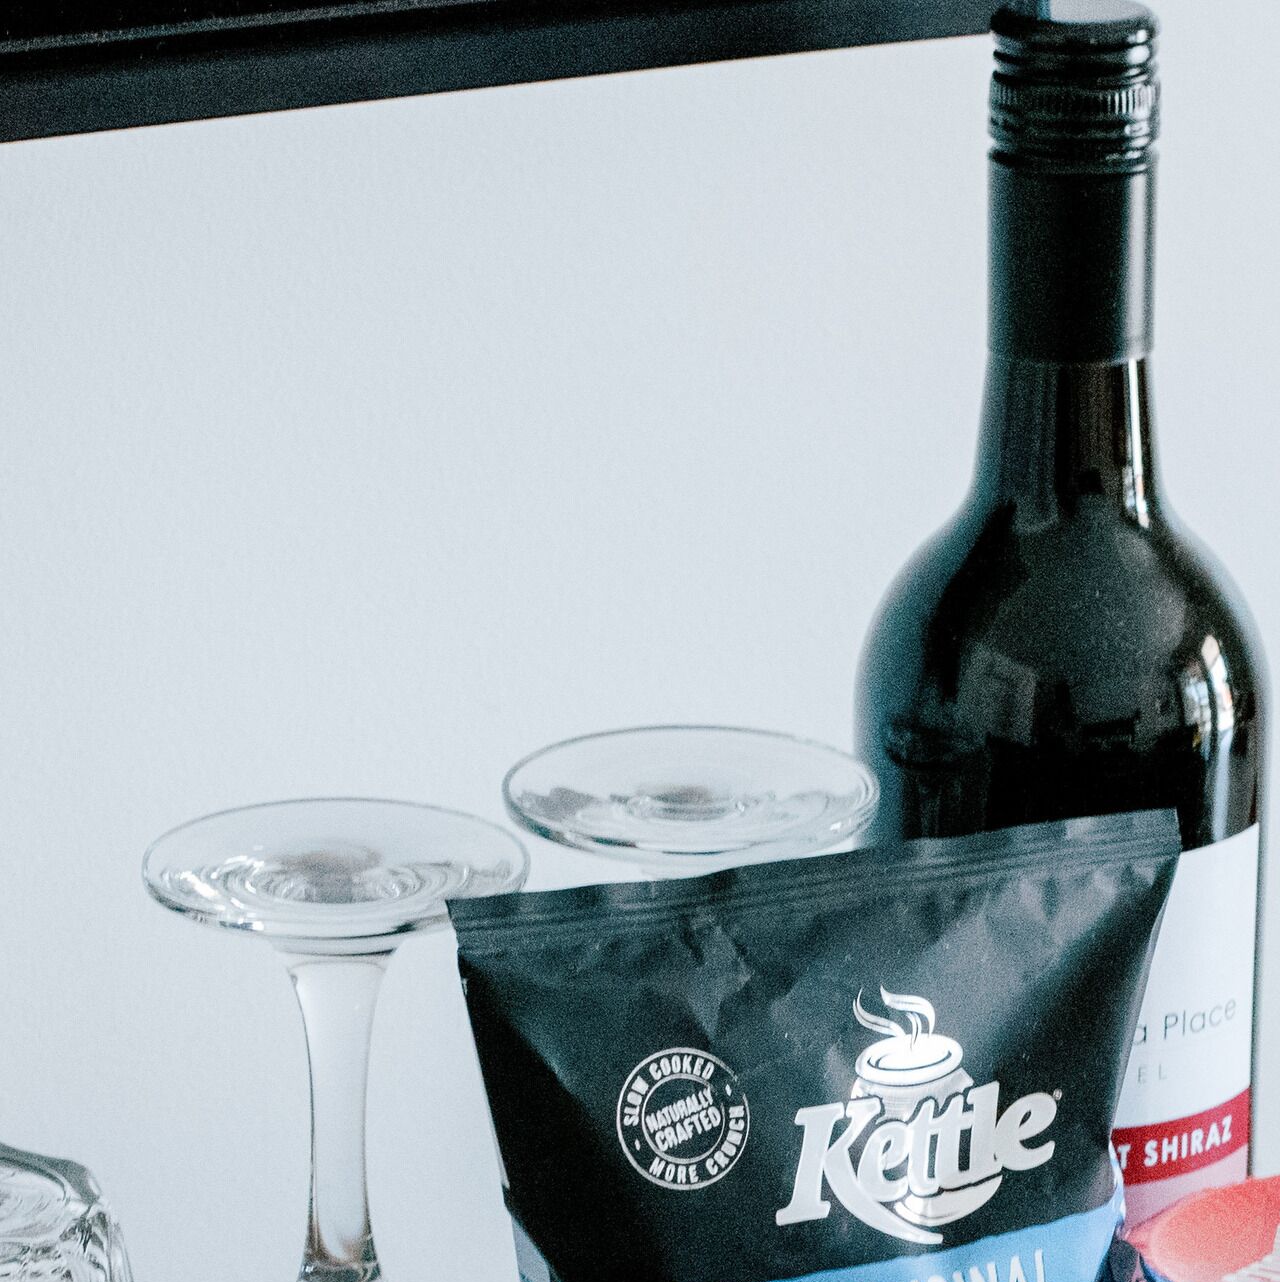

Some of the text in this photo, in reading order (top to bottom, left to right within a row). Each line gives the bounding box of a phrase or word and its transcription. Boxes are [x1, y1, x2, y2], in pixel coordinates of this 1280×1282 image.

[1164, 999, 1236, 1040] Place
[623, 1054, 715, 1126] SLOW COOKED
[645, 1085, 713, 1134] NATURALLY
[648, 1105, 745, 1184] MORE CRUNCH
[654, 1106, 721, 1152] CRAFTED
[1144, 1115, 1232, 1168] SHIRAZ
[776, 1081, 1058, 1244] Kettle
